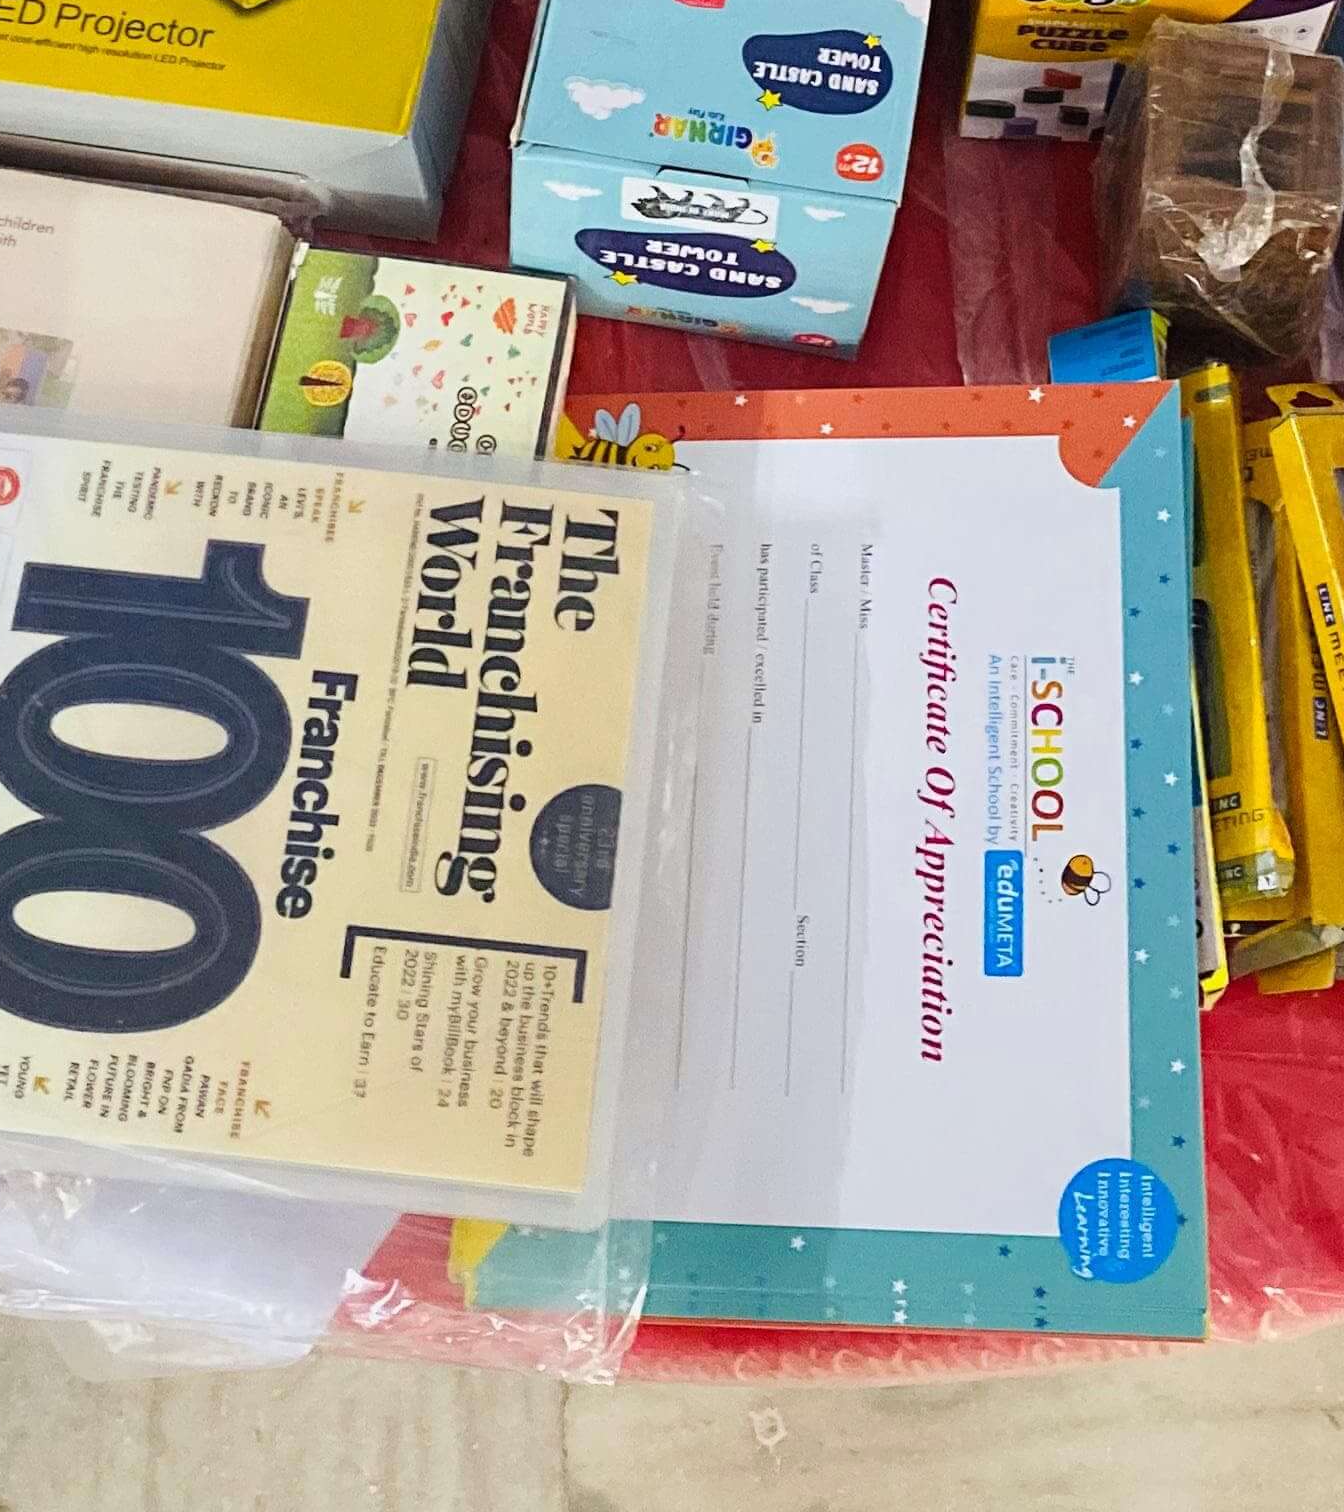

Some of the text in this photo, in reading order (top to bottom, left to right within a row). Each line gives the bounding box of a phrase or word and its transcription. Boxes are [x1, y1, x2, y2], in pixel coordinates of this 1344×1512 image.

[54, 3, 215, 49] Projector
[753, 61, 880, 96] SAND CASTLE
[817, 47, 883, 73] TOWER
[654, 111, 753, 149] GIRNAR
[598, 246, 783, 289] SAND CASTLE
[646, 239, 741, 266] TOWER
[523, 302, 537, 336] WORLD
[536, 303, 550, 339] HAPPY
[90, 459, 112, 518] FRANCHISE
[128, 470, 145, 513] TESTING
[259, 482, 274, 519] ICONIC
[404, 493, 487, 690] World
[555, 507, 622, 633] The
[859, 544, 873, 629] Master Miss
[752, 543, 773, 723] has participated excelled in
[1317, 582, 1334, 625] LINC
[435, 498, 555, 904] Franchising
[794, 543, 823, 968] of Class Section
[1030, 655, 1067, 842] i-SCHOOL
[274, 669, 361, 919] Franchise
[914, 576, 959, 1063] Certificate Of Appreciation
[984, 653, 1020, 969] An Intelligent School by eduMETA
[366, 946, 388, 1008] Educate
[364, 1012, 378, 1028] to
[409, 952, 437, 1072] Shining Stars of
[457, 956, 489, 1108] Grow your business
[488, 960, 520, 1109] 2022 & beyond 20
[0, 1065, 10, 1085] YET
[14, 1056, 32, 1099] YOUNG
[358, 1032, 375, 1066] Earn
[505, 961, 535, 1148] up the business block in
[534, 1042, 549, 1074] that
[64, 1061, 81, 1101] RETAIL
[82, 1059, 99, 1109] FLOWER
[99, 1054, 119, 1118] FUTURE IN
[118, 1054, 138, 1122] BLOOMING
[158, 1069, 174, 1115] FNP ON
[173, 1055, 195, 1133] GADIA FROM
[195, 1074, 211, 1118] PAWAN
[529, 1079, 544, 1107] will
[522, 1109, 541, 1158] shape
[1071, 1190, 1098, 1279] Learning
[1097, 1171, 1112, 1259] Innovative
[1116, 1171, 1133, 1262] Interesting
[1138, 1174, 1154, 1259] Intelligent
